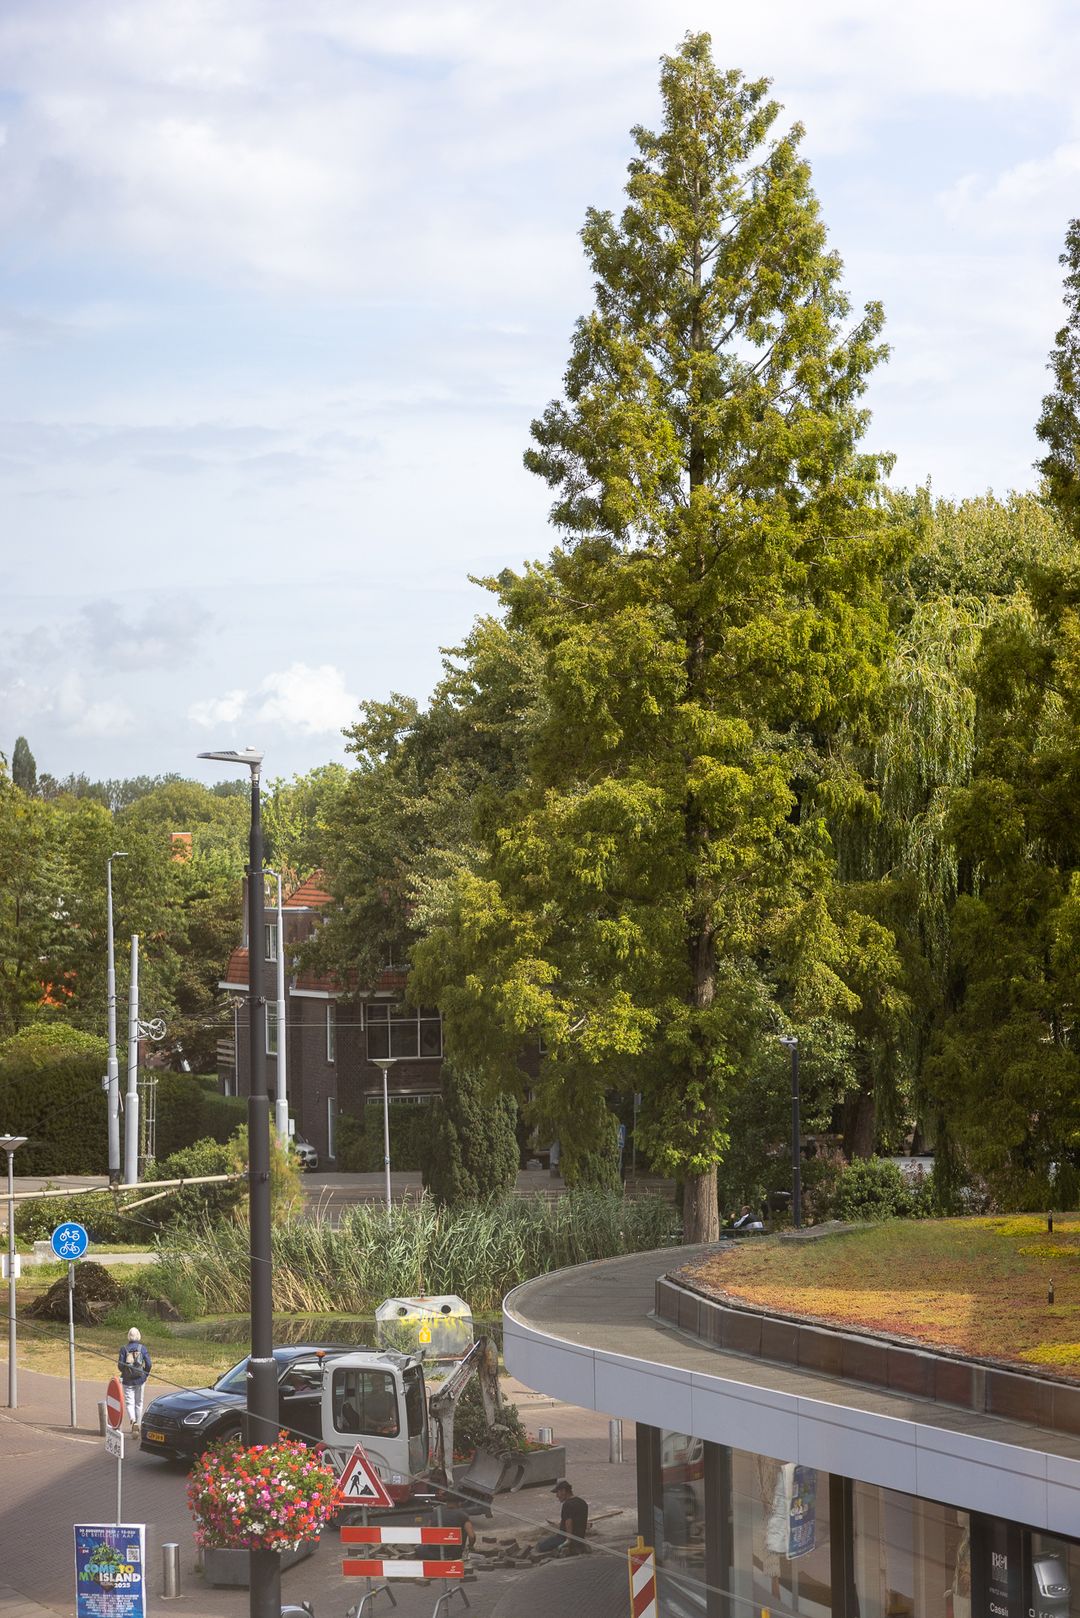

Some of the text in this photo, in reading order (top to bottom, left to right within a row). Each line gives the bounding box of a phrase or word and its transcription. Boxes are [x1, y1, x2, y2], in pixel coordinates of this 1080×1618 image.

[84, 1563, 135, 1574] COME TO
[79, 1572, 141, 1582] MY ISLAND
